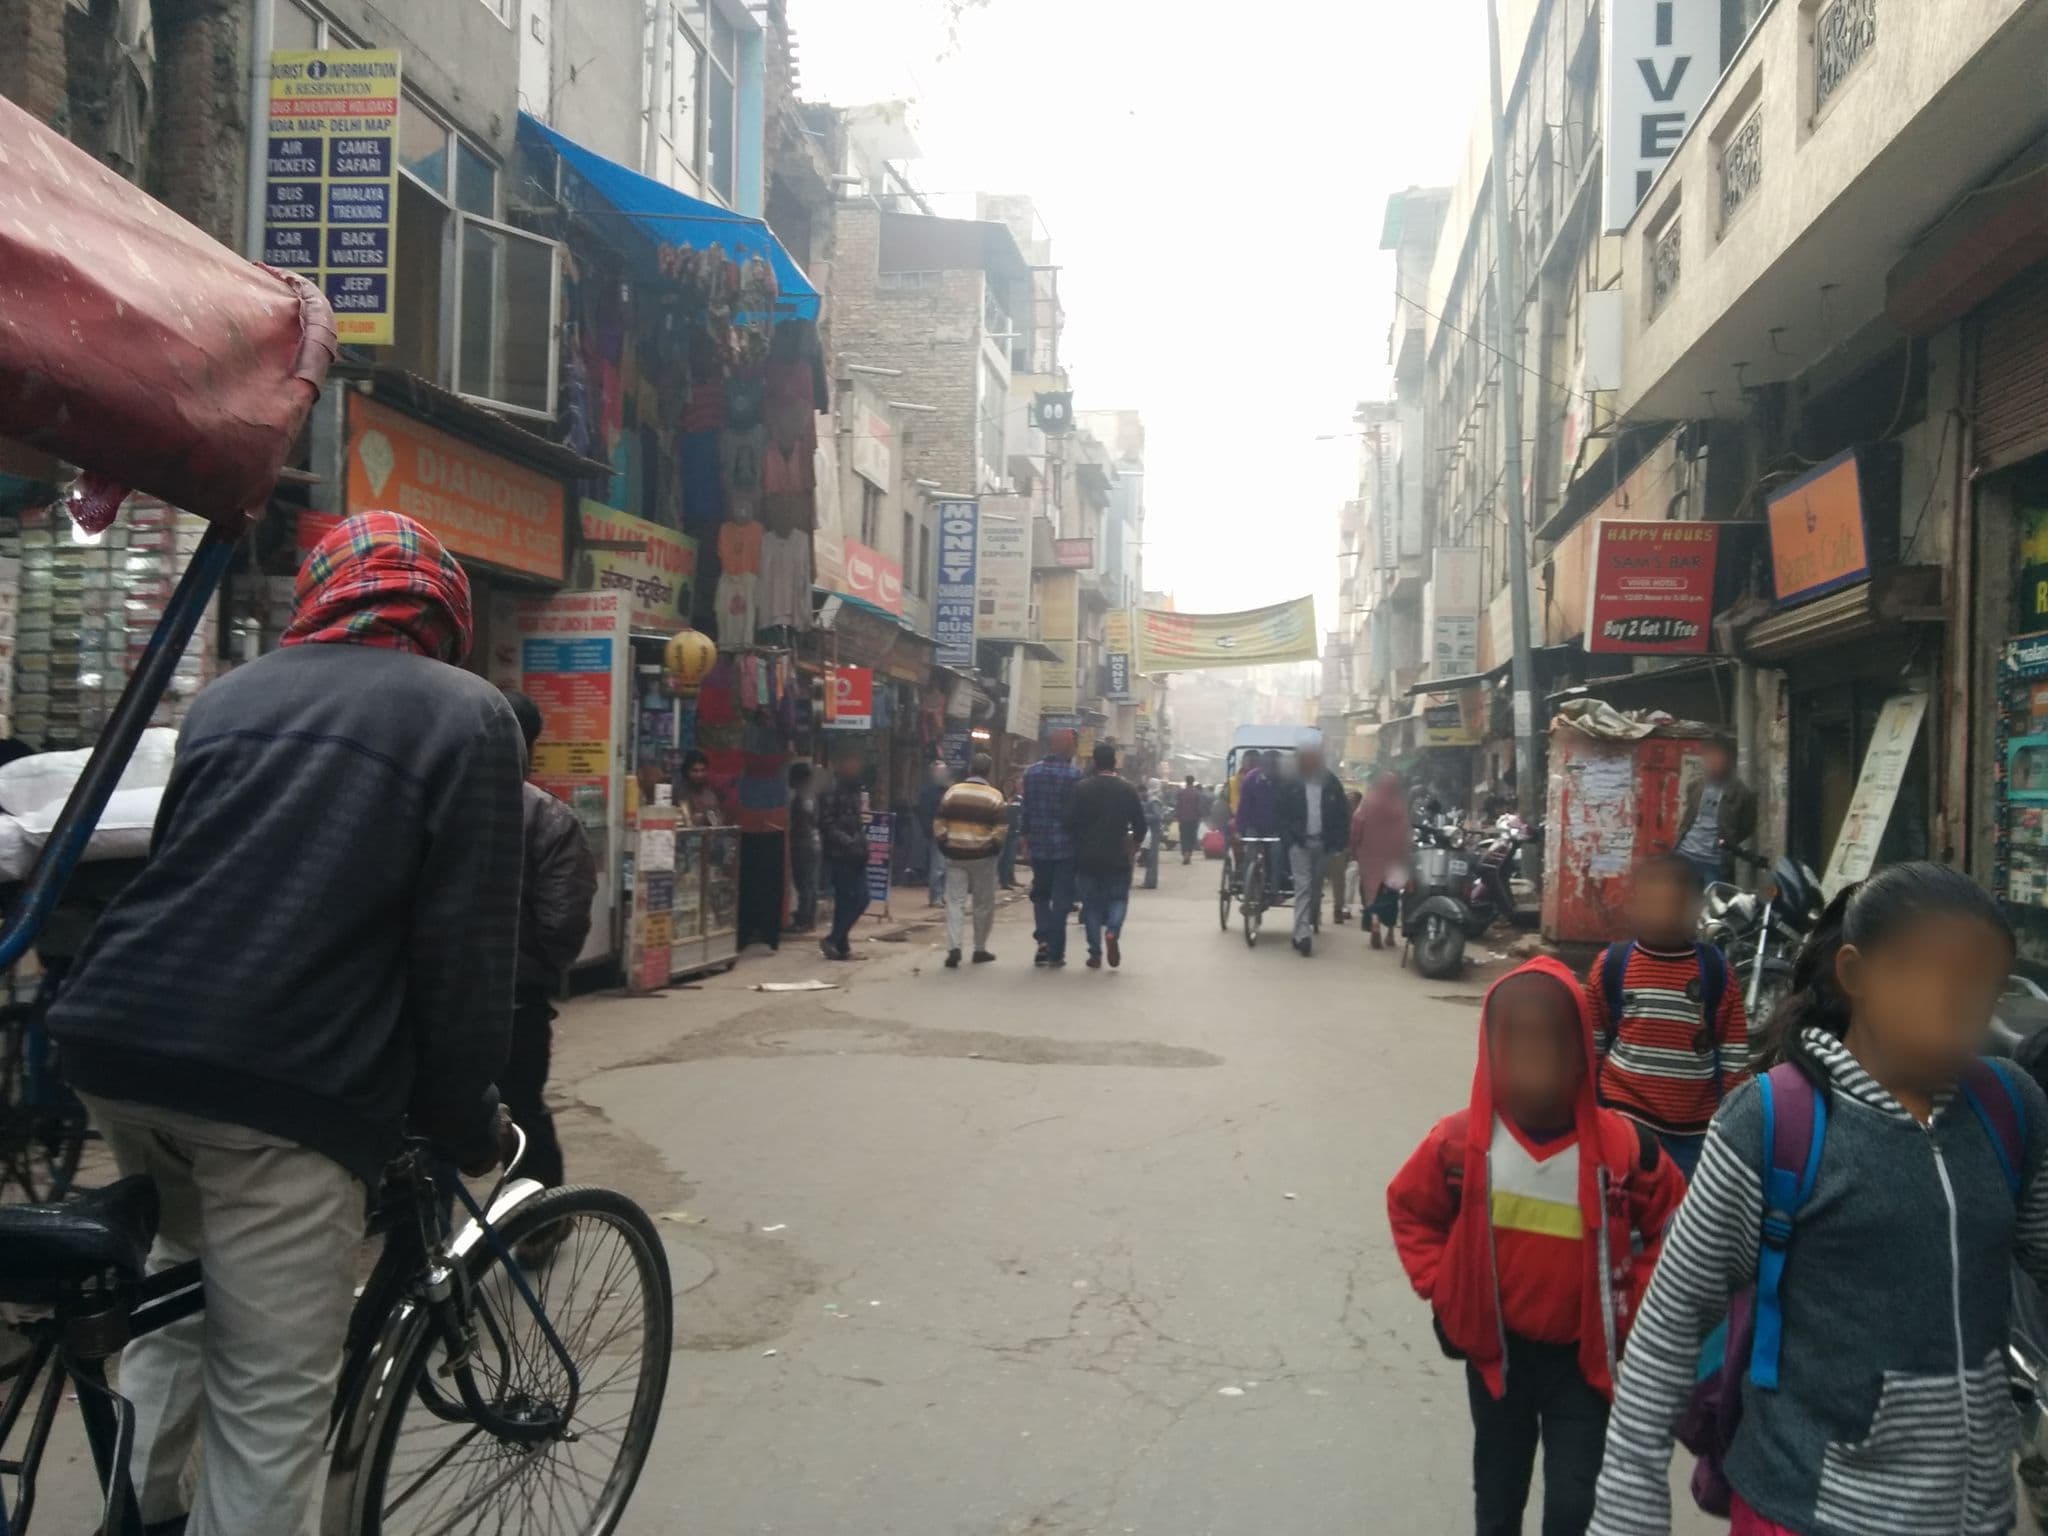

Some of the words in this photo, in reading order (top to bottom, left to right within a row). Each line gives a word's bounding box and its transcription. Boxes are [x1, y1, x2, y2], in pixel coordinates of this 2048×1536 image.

[329, 63, 397, 79] INFORMATION
[284, 83, 292, 95] &
[296, 82, 372, 96] RESERVATION
[1636, 1, 1692, 208] IVE
[331, 119, 361, 132] DELHI
[365, 119, 391, 132] MAP
[281, 140, 303, 155] AIR
[338, 140, 381, 155] CAMEL
[268, 157, 316, 173] TICKETS
[336, 157, 381, 173] SAFARI
[277, 186, 304, 201] BUS
[331, 186, 384, 202] HIMALAYA
[332, 204, 383, 220] TREKKING
[276, 231, 302, 246] CAR
[341, 231, 376, 246] BACK
[332, 249, 384, 264] WATERS
[341, 276, 373, 291] JEEP
[333, 294, 379, 309] SAFARI
[417, 447, 548, 524] DIAMOND
[1607, 527, 1658, 541] HAPPY
[1662, 528, 1713, 542] HOURS
[943, 504, 974, 582] MONEY
[1669, 555, 1703, 569] BAR
[939, 605, 971, 616] AIR
[938, 621, 972, 632] BUS
[1604, 620, 1627, 640] Buy
[1628, 620, 1639, 636] 2
[1639, 620, 1661, 636] Get
[1663, 620, 1671, 636] 1
[1673, 621, 1699, 637] Free
[1111, 655, 1125, 691] MONEY
